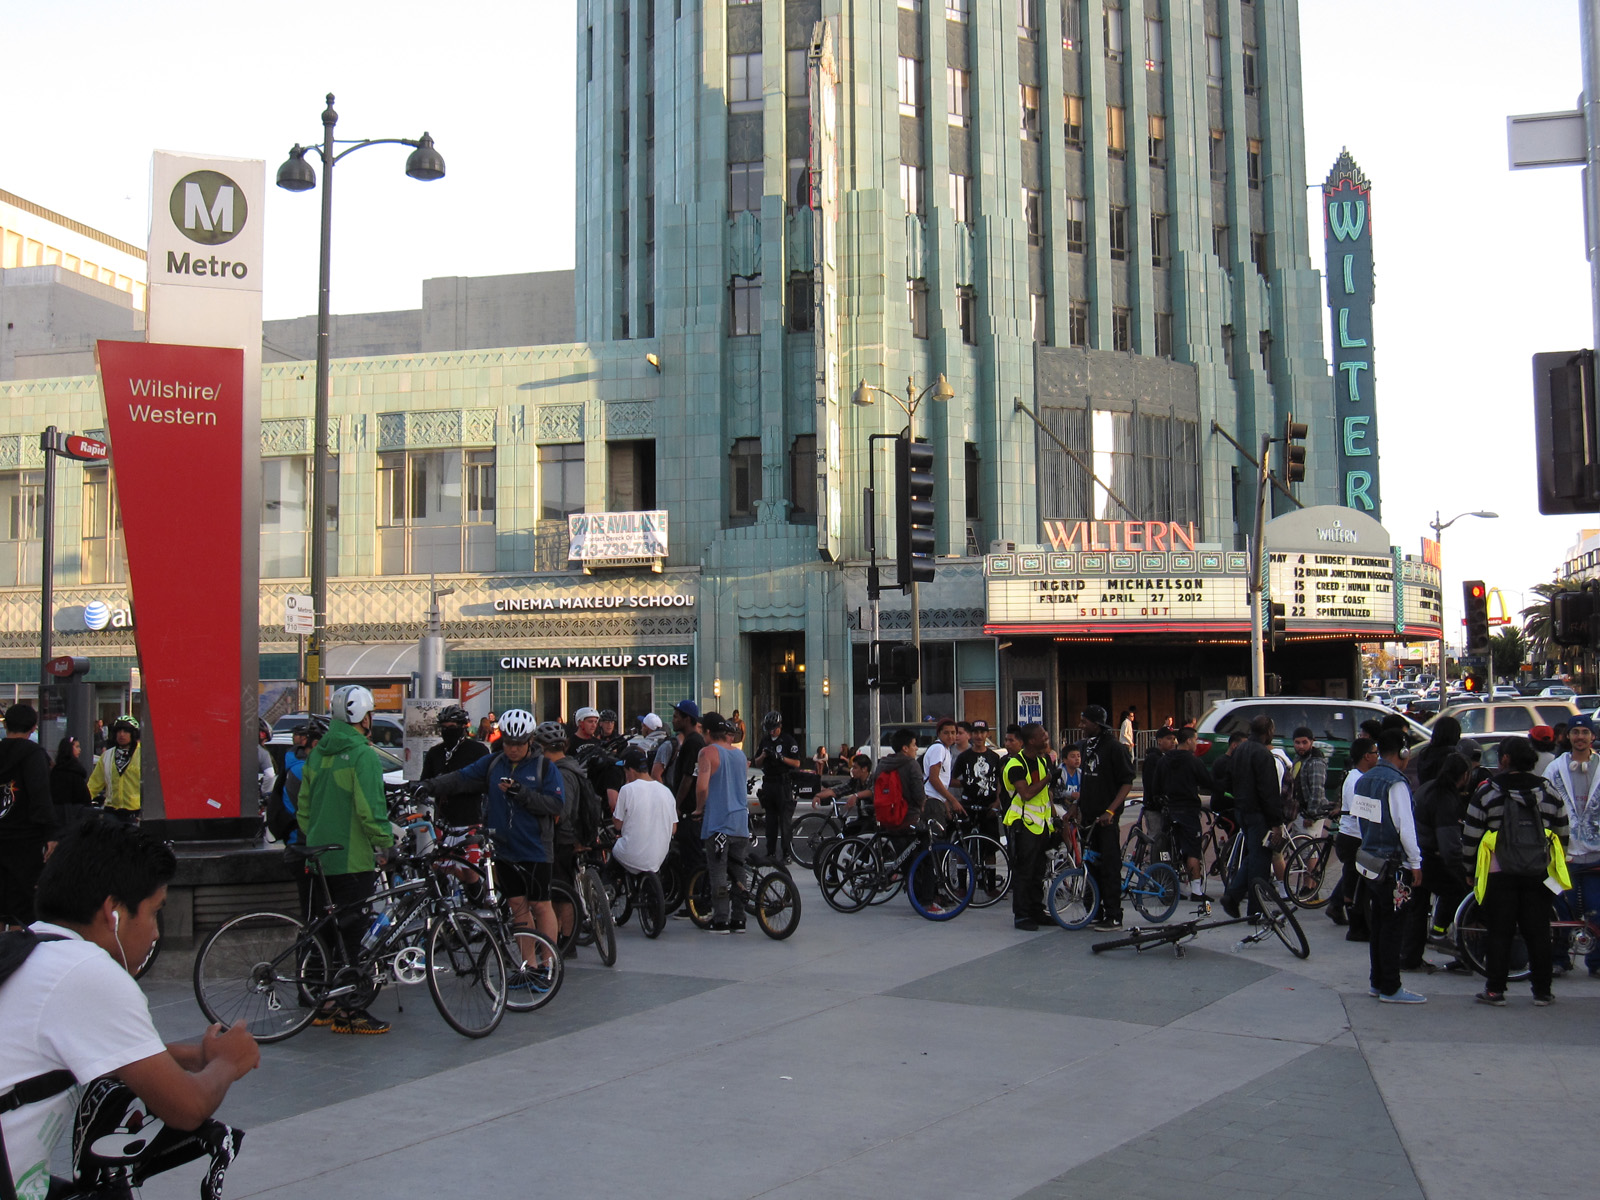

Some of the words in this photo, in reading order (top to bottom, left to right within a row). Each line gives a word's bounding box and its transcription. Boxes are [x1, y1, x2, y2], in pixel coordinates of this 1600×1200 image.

[166, 250, 248, 279] Metro
[129, 378, 222, 401] Wilshire/
[128, 404, 217, 426] Western
[80, 441, 107, 456] Rapid
[1043, 520, 1195, 551] WILTERN
[1317, 527, 1357, 544] WILTERN
[1269, 554, 1287, 563] MAY
[1298, 554, 1306, 565] 4
[1315, 555, 1346, 565] LINDSEY
[1294, 568, 1306, 578] 12
[1306, 568, 1328, 577] BRIAN
[1330, 569, 1367, 579] JONESTOWN
[1034, 579, 1086, 591] INGRID
[1107, 578, 1204, 590] MICHAELSON
[1294, 581, 1305, 591] 15
[1316, 582, 1340, 591] CREED
[1347, 583, 1370, 592] HUMAN
[1375, 584, 1390, 593] CLAY
[494, 598, 554, 611] CINEMA
[559, 595, 625, 609] MAKEUP
[629, 594, 695, 608] SCHOOL
[1039, 593, 1079, 604] FRIDAY
[1101, 593, 1135, 603] APRIL
[1151, 593, 1164, 602] 27
[1178, 593, 1203, 602] 2012
[1316, 595, 1336, 603] BEST
[1343, 595, 1366, 604] COAST
[1080, 607, 1118, 617] SOLD
[1141, 607, 1170, 616] OUT
[1291, 607, 1306, 617] 22
[1316, 608, 1371, 617] SPIRITUALIZED
[286, 623, 298, 631] 710
[500, 656, 561, 669] CINEMA
[567, 654, 633, 668] MAKEUP
[637, 653, 688, 667] STORE
